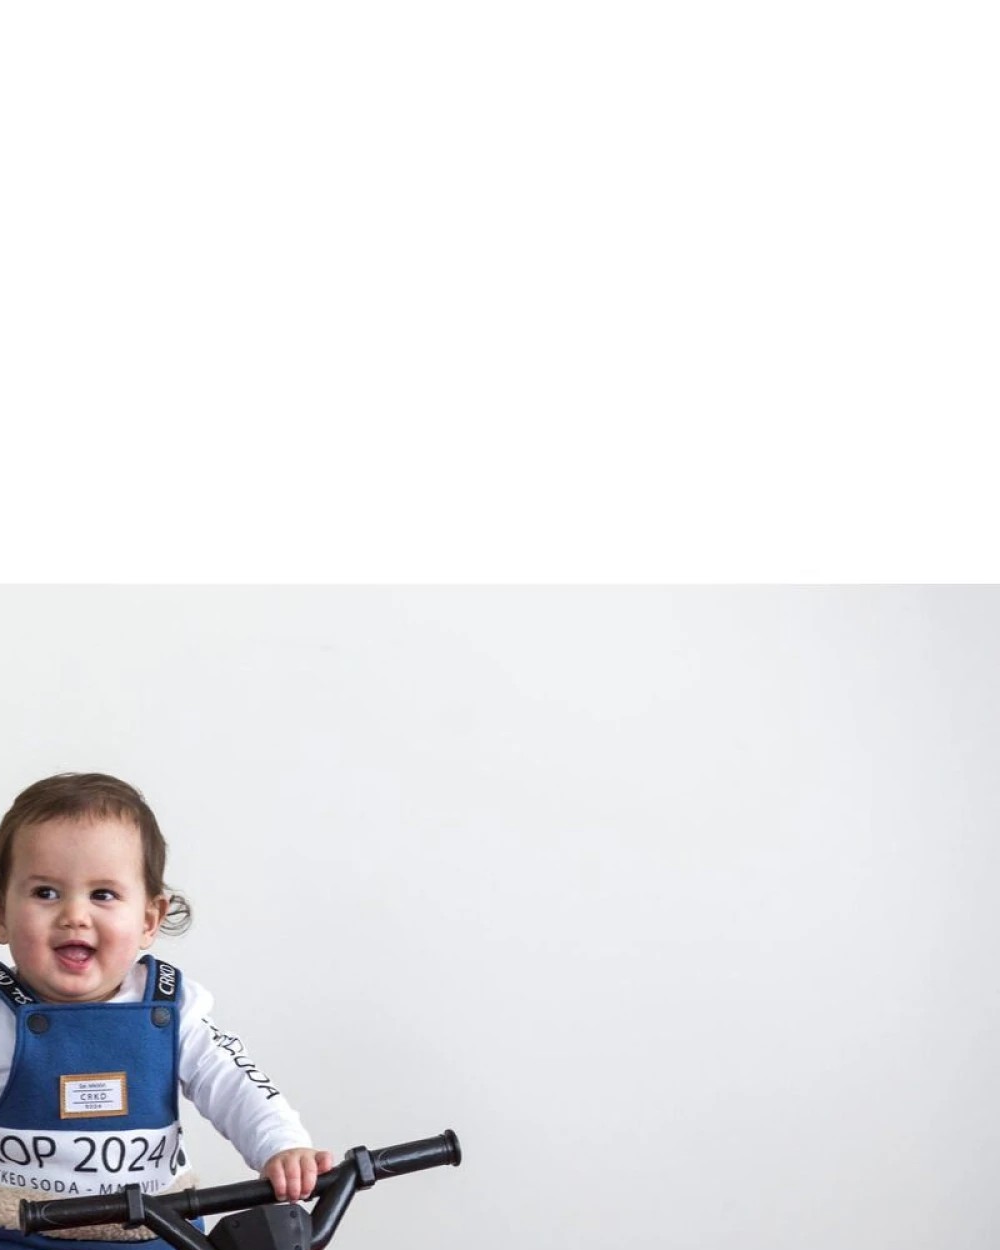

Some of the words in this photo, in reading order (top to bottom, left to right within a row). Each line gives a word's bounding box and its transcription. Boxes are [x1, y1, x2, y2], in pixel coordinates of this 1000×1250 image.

[158, 964, 176, 995] CRKD
[80, 1092, 107, 1101] CRKD
[73, 1135, 167, 1173] 2024
[30, 1177, 80, 1195] SODA
